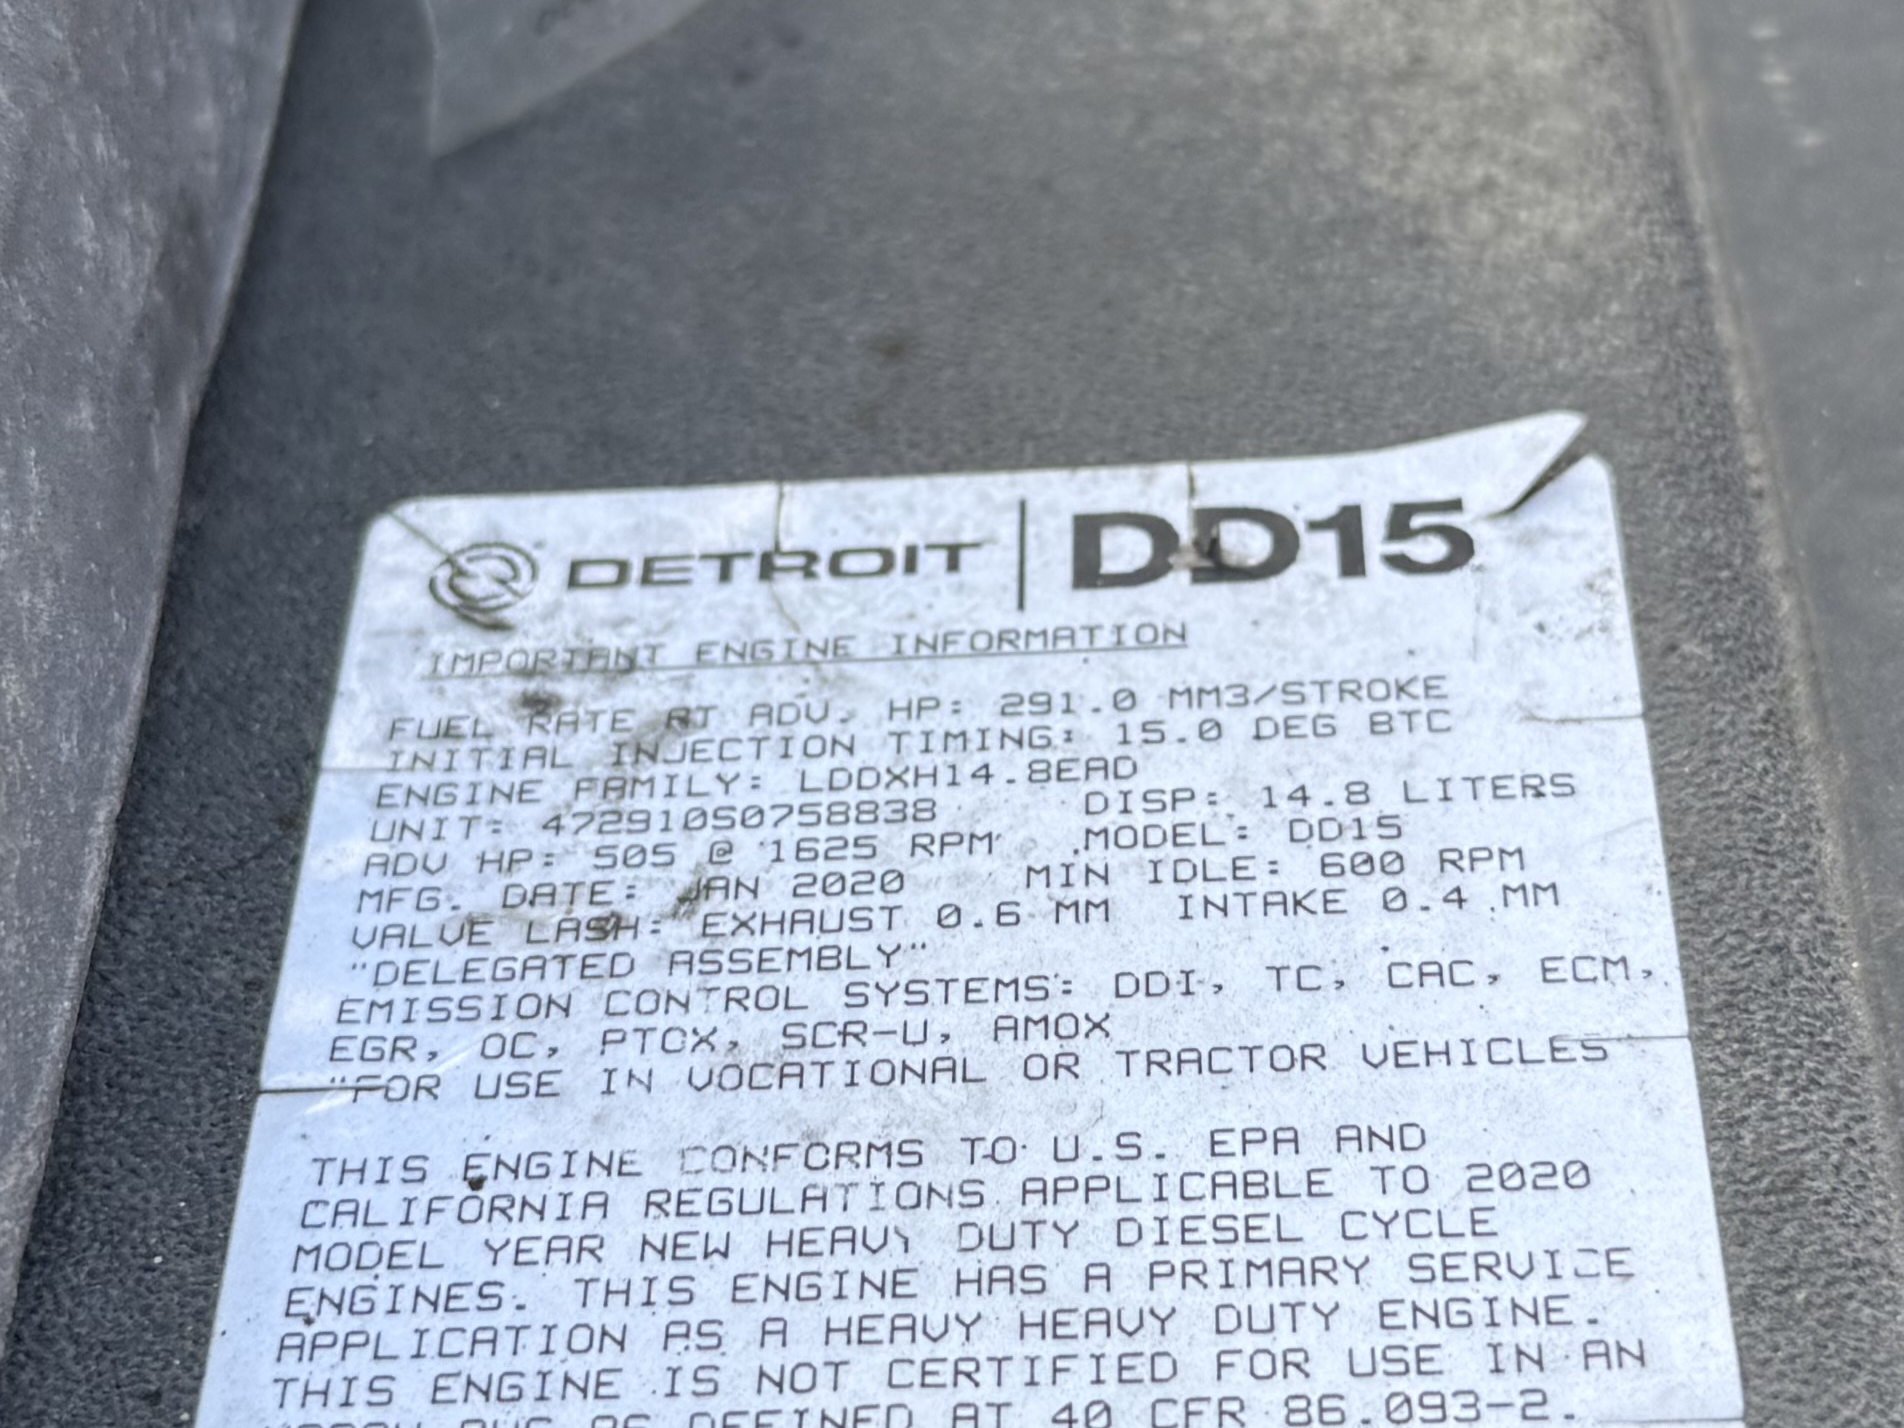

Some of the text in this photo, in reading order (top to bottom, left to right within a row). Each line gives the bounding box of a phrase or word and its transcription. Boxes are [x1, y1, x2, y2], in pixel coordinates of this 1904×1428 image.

[567, 497, 1474, 591] DETROIT DD15
[429, 623, 1188, 676] IMPORTANT ENGINE INFORMATION
[386, 675, 1448, 742] FUEL RATE AT ADV. HP: 291.0 MM3/STROKE
[386, 709, 1451, 772] INITIAL INJECTION TIMING: 15.0 DEG BTC
[370, 816, 502, 842] UNIT:
[1085, 788, 1217, 815] DISP:
[1262, 781, 1370, 809] 14.8
[1403, 773, 1576, 804] LITERS
[376, 756, 1137, 809] ENGINE FAMILY: LDDXH14.8EAD
[364, 815, 1402, 877] ADV HP: 505 @ 1625 RPM MODEL: DD15
[357, 847, 1525, 913] MFG. DATE: JAN 2020 MIN IDLE: 600 RPM
[352, 882, 1559, 950] VALVE LASH: EXHAUST 0.6 MM INTAKE 0.4 MM
[336, 955, 1652, 1024] EMISSION CONTROL SYSTEMS: DDI, TC, CAC, ECM,
[352, 942, 926, 987] "DELEGATED ASSEMBLY"
[329, 1036, 438, 1062] EGR,
[480, 1032, 558, 1060] OC,
[782, 1019, 950, 1051] SCR-U,
[993, 1012, 1110, 1044] AMOX
[474, 1070, 562, 1100] USE
[600, 1068, 653, 1096] IN
[688, 1056, 987, 1092] VOCATIONAL
[1023, 1052, 1079, 1081] OR
[1115, 1043, 1327, 1077] TRACTOR
[1362, 1037, 1609, 1070] VEHICLES
[312, 1123, 1426, 1186] THIS ENGINE CONFORMS TO U.S. EPA AND
[301, 1160, 1591, 1229] CALIFORNIA REGULATIONS APPLICABLE TO 2020
[292, 1206, 1498, 1273] MODEL YEAR NEW HEAVY DUTY DIESEL CYCLE
[285, 1247, 1635, 1317] ENGINES. THIS ENGINE HAS A PRIMARY SERVICE
[276, 1294, 1598, 1363] APPLICATION AS A HEAVY HEAVY DUTY ENGINE.
[273, 1339, 1646, 1409] THIS ENGINE IS NOT CERTIFIED FOR USE IN AN
[1284, 1388, 1575, 1427] 86.093-2.
